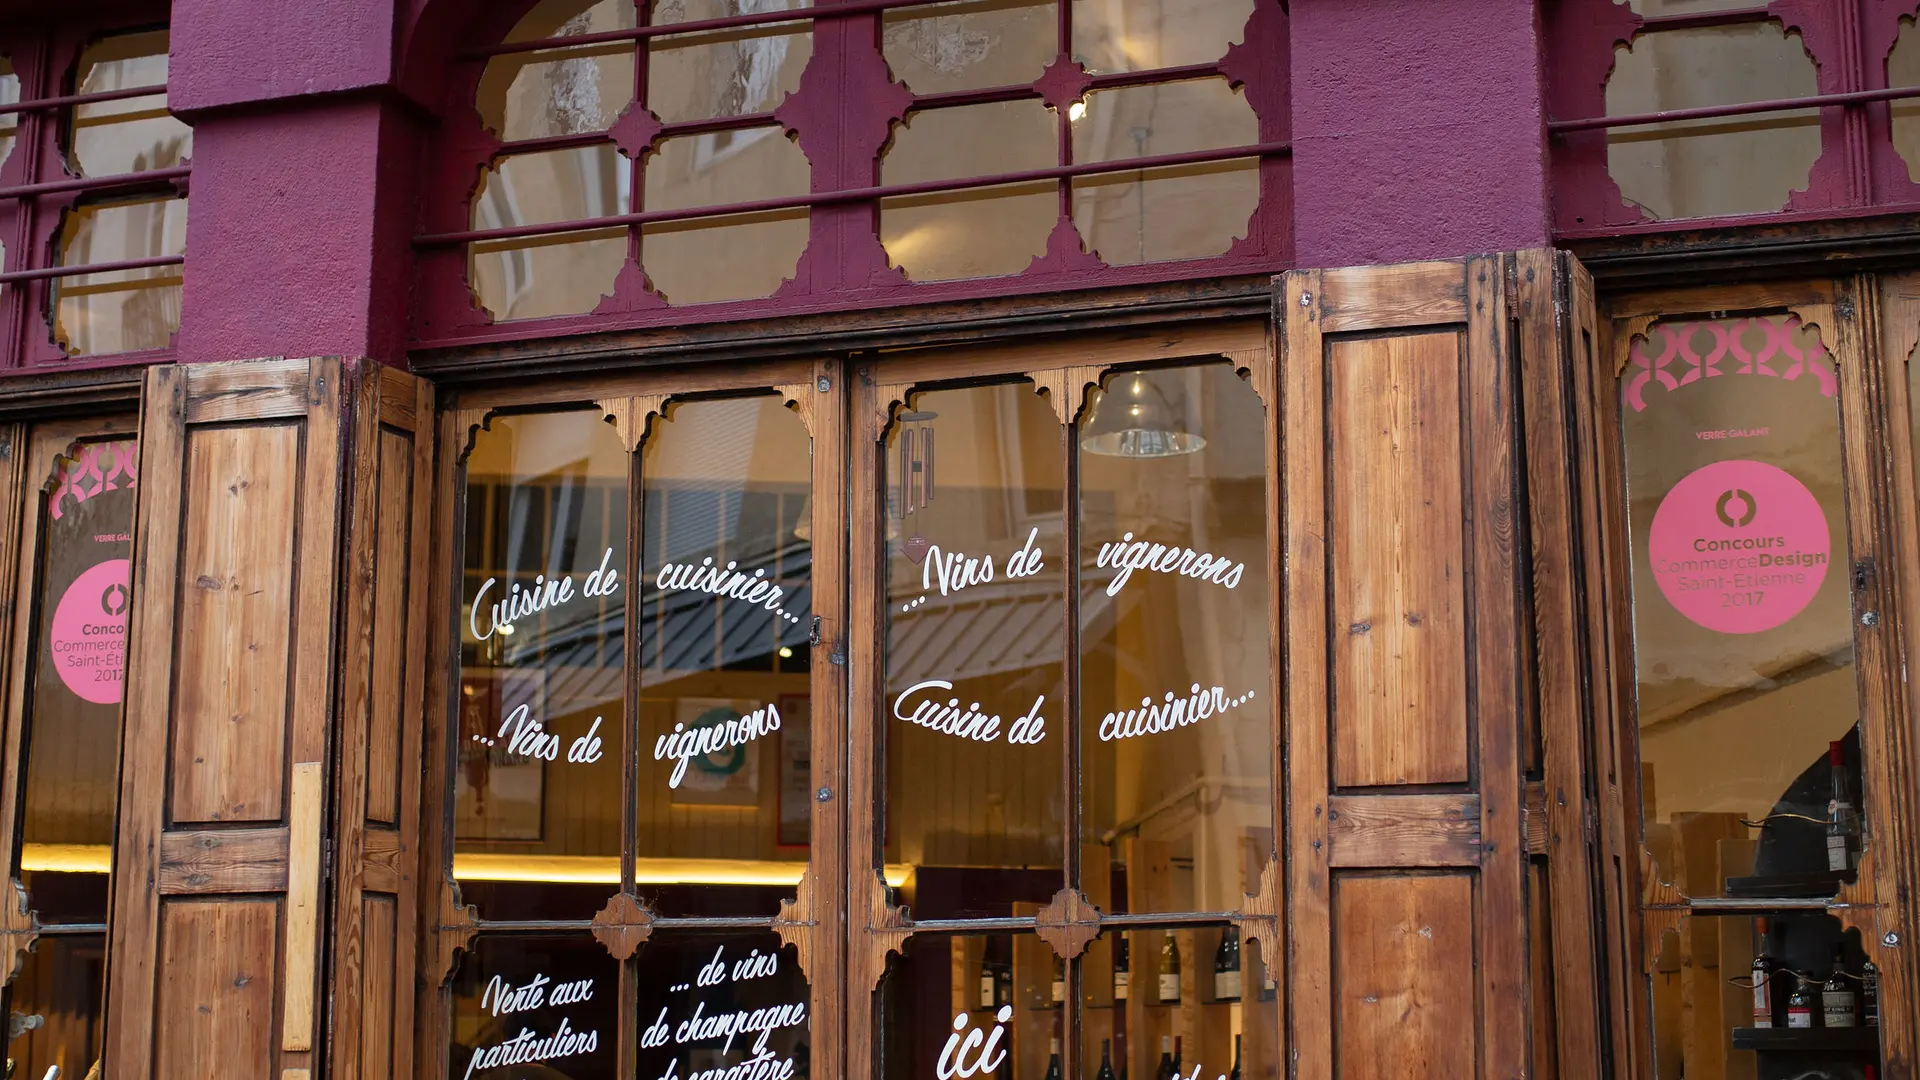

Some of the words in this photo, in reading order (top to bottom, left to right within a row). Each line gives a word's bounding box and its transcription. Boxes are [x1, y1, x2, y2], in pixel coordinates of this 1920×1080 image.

[1695, 429, 1727, 440] VERRE
[1728, 427, 1771, 439] GALANT
[93, 534, 116, 542] VERRE
[1693, 535, 1786, 552] Concours
[1006, 526, 1044, 579] de
[1096, 531, 1245, 597] vignerons
[470, 575, 575, 640] Cuisine
[583, 547, 618, 597] de
[1721, 591, 1765, 608] 2017
[54, 639, 124, 653] Commerce
[893, 680, 1001, 743] Cuisine
[1008, 694, 1046, 745] de
[568, 716, 603, 763] de
[654, 703, 781, 789] vignerons
[732, 949, 778, 982] vins
[481, 973, 550, 1017] Vente
[549, 978, 594, 1007] aux
[463, 1017, 597, 1080] particuliers
[641, 1006, 670, 1049] de
[675, 1001, 806, 1055] champagne
[936, 1004, 1013, 1080] ici
[657, 1058, 679, 1080] d
